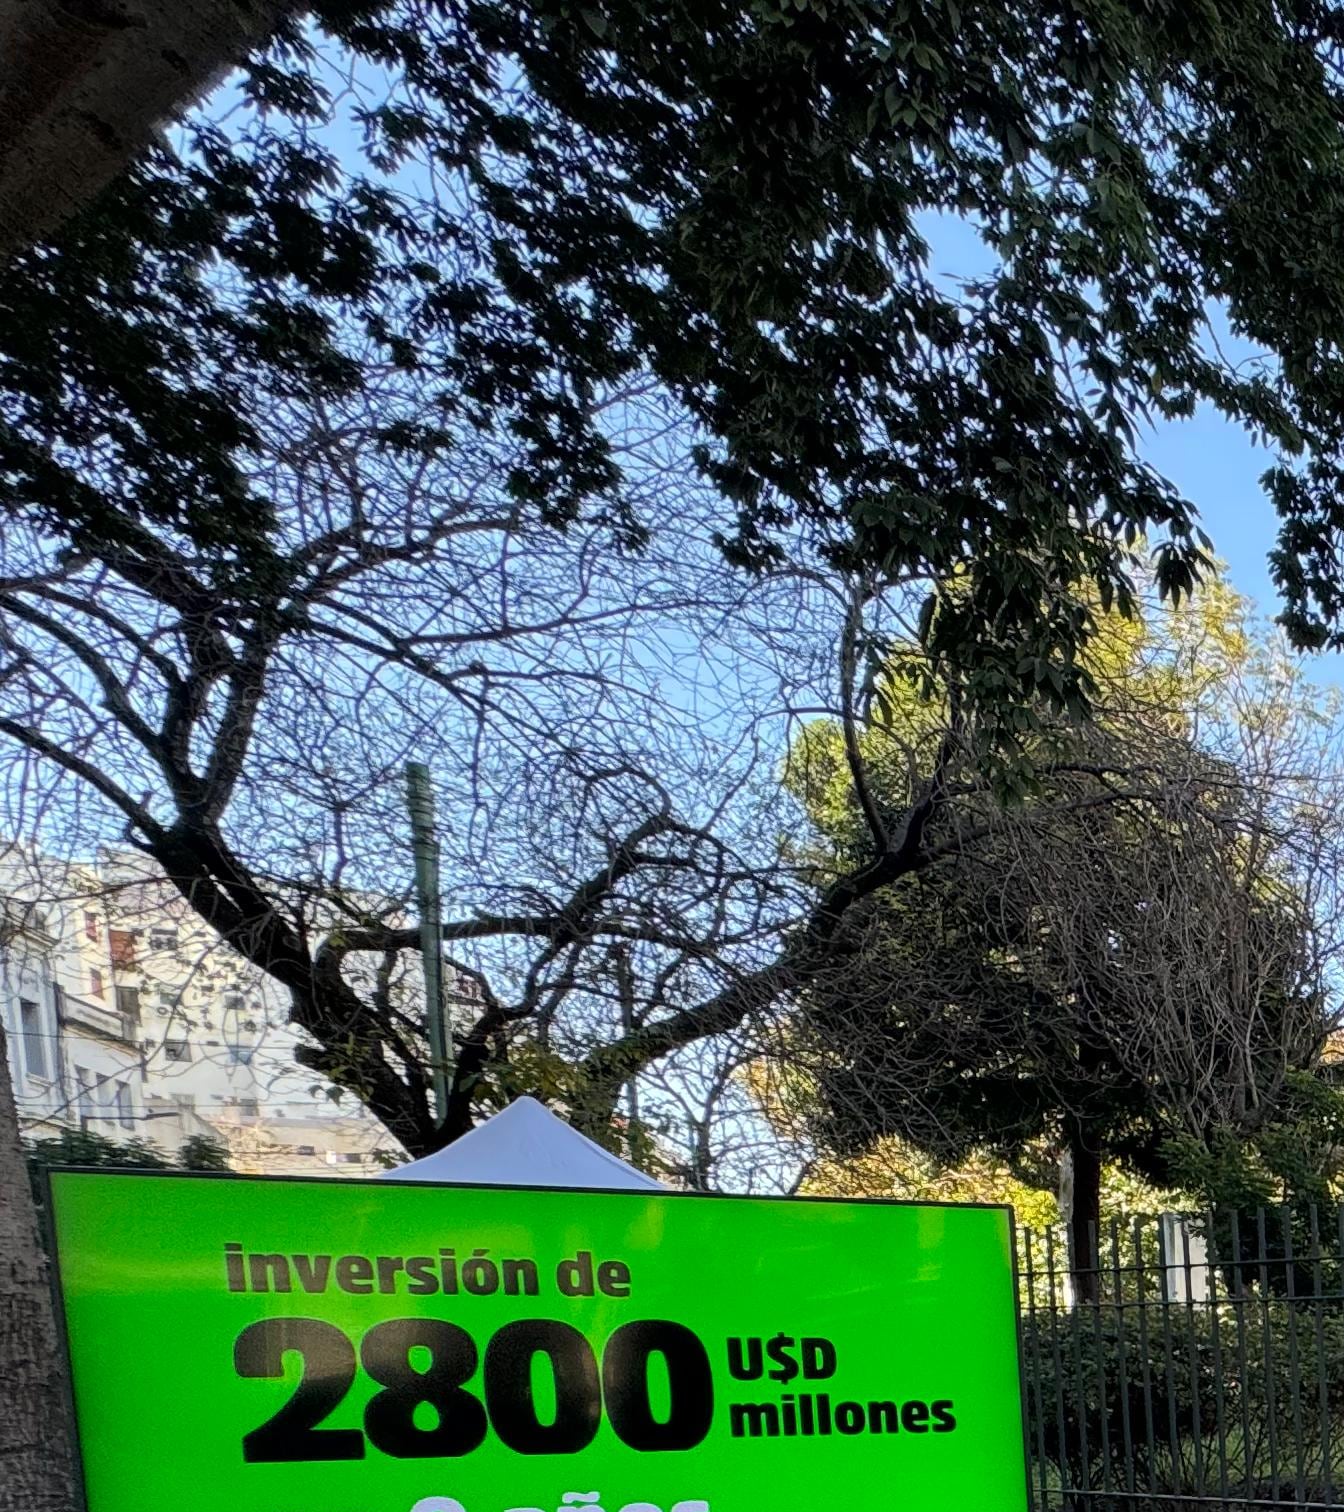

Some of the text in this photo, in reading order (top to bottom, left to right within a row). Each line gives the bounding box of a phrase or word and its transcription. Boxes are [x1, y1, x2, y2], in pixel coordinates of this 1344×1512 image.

[223, 1242, 632, 1298] inversión de
[726, 1331, 837, 1386] U$D
[233, 1317, 715, 1464] 2800
[729, 1393, 957, 1438] millones
